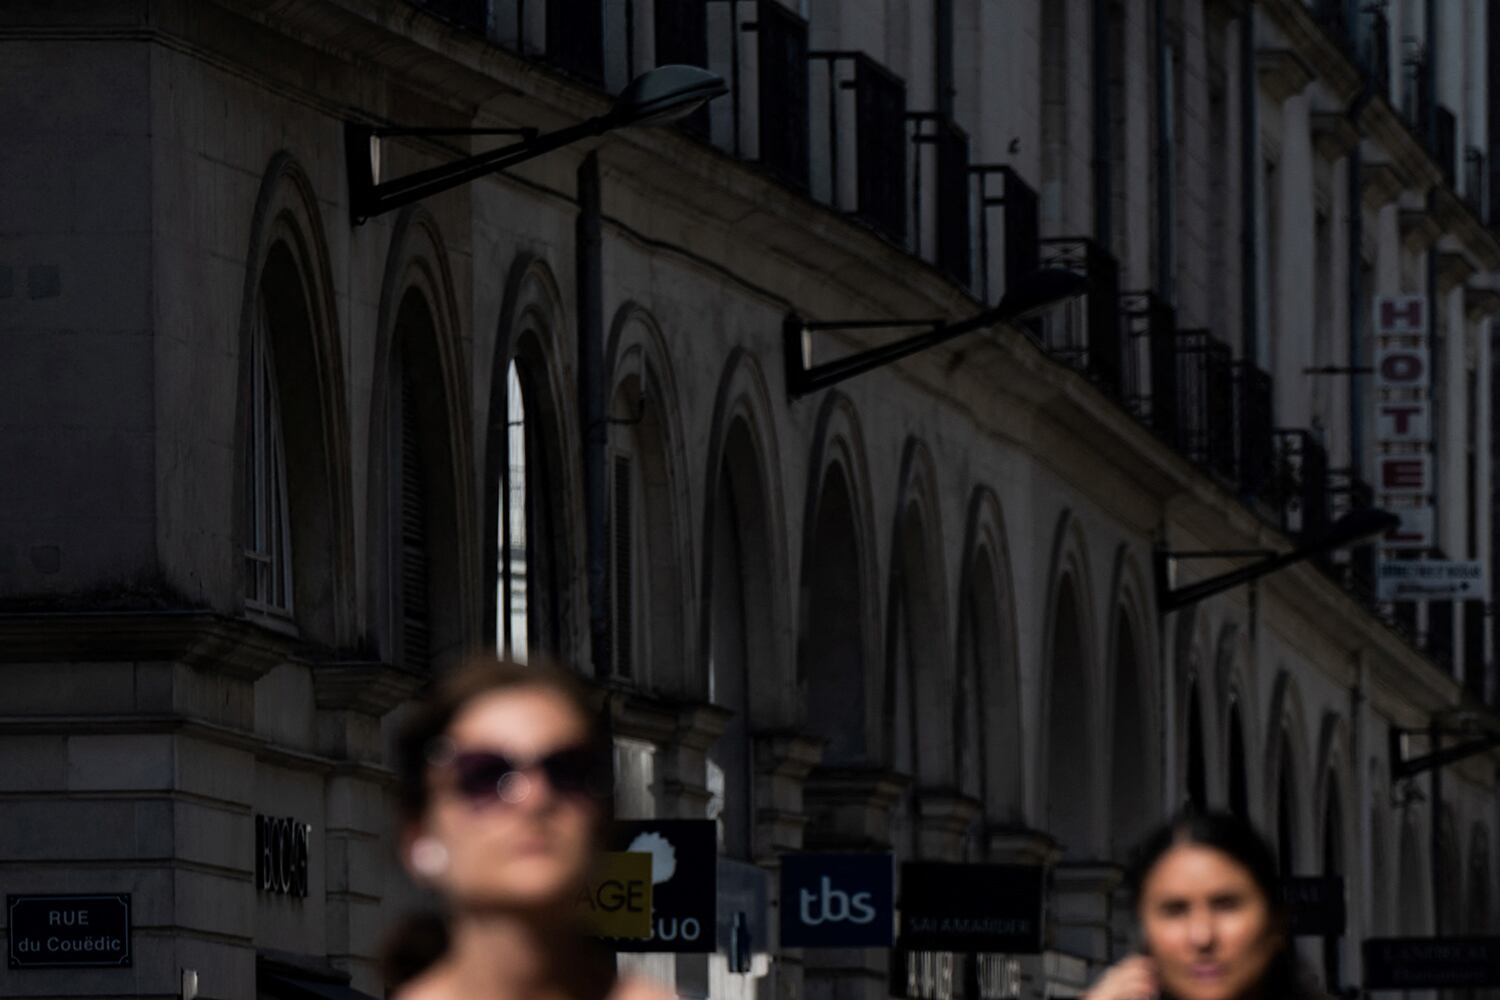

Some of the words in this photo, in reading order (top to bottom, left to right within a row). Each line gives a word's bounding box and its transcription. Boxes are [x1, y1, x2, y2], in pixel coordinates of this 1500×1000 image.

[798, 875, 877, 928] tbs
[49, 910, 90, 927] RUE
[18, 937, 39, 953] du
[46, 937, 121, 953] Couëdic
